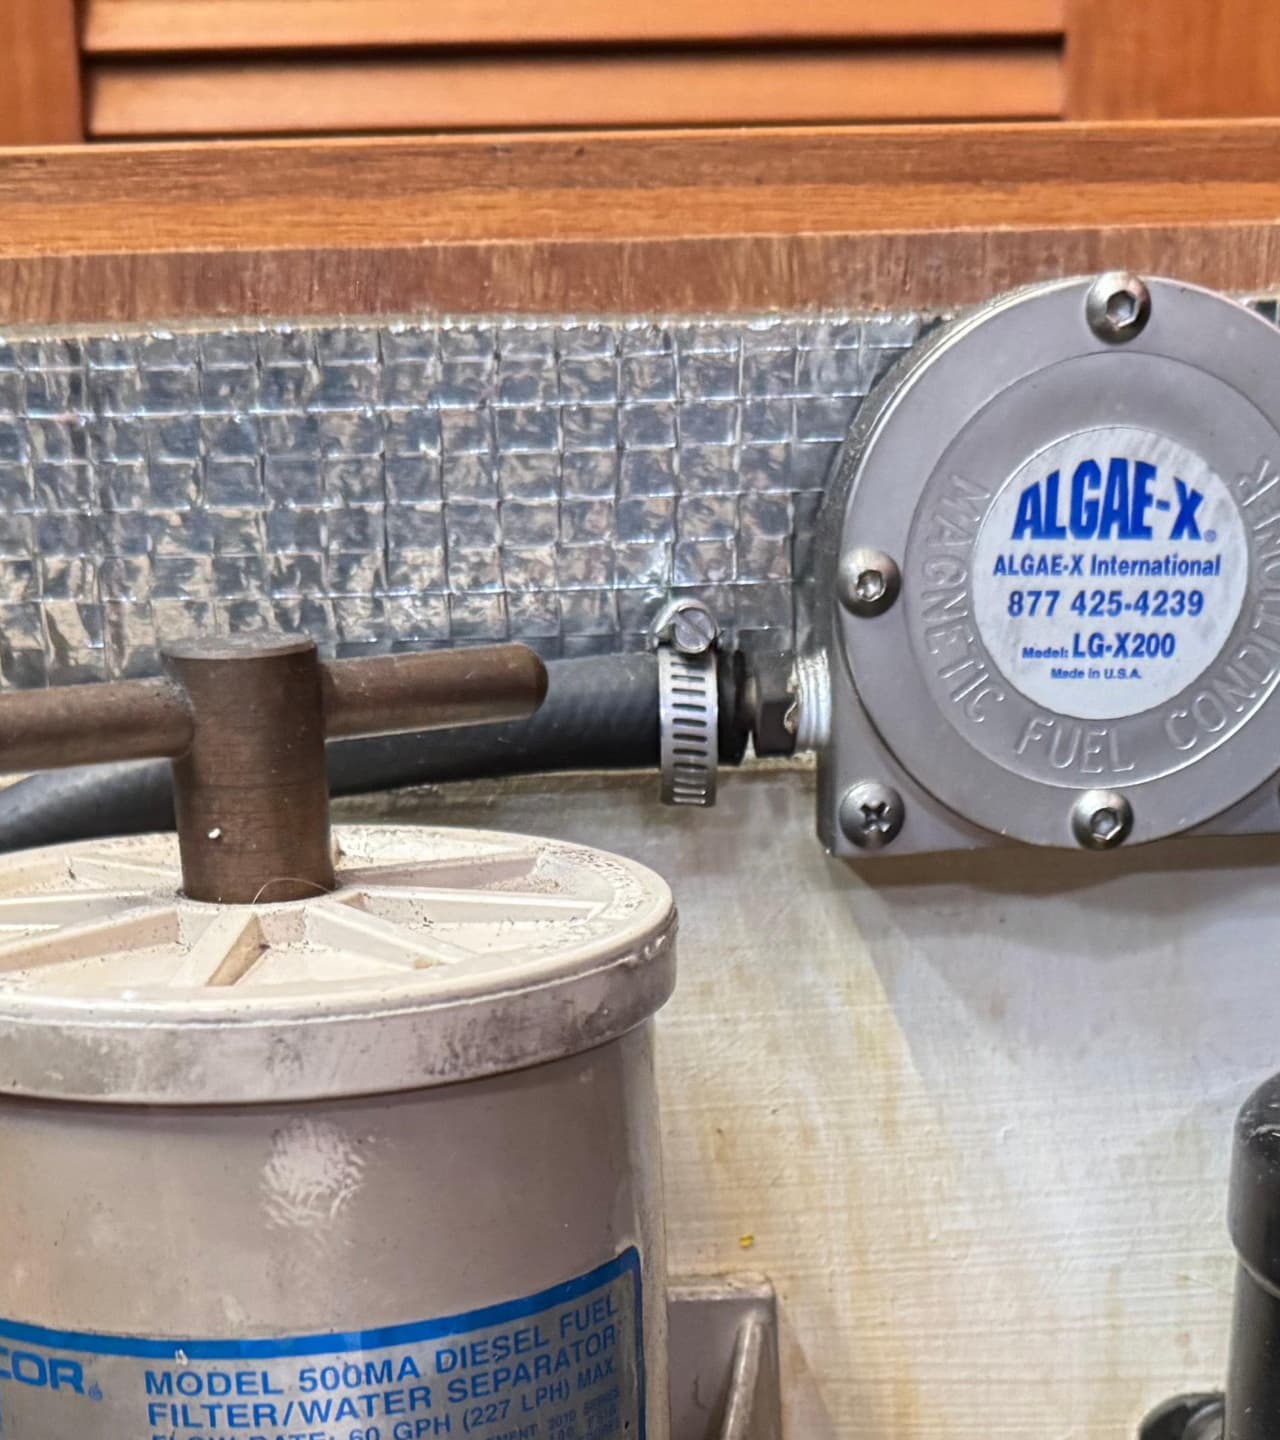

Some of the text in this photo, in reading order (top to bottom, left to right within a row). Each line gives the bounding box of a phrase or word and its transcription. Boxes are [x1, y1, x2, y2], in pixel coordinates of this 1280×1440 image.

[1010, 457, 1204, 542] ALGAE-X
[992, 553, 1222, 578] ALGAE-X International
[920, 472, 1006, 724] MAGNETIC
[1006, 590, 1205, 618] 877 425-4239
[1021, 632, 1177, 660] Model: LG-X200
[1050, 667, 1143, 680] Made in U.S.A.
[1014, 717, 1137, 775] FUEL
[143, 1292, 619, 1397] MODEL 500MA DIESEL FUEL
[146, 1323, 617, 1429] FILTER/WATER SEPARATOR
[462, 1399, 512, 1433] (227
[521, 1379, 570, 1414] LPH)
